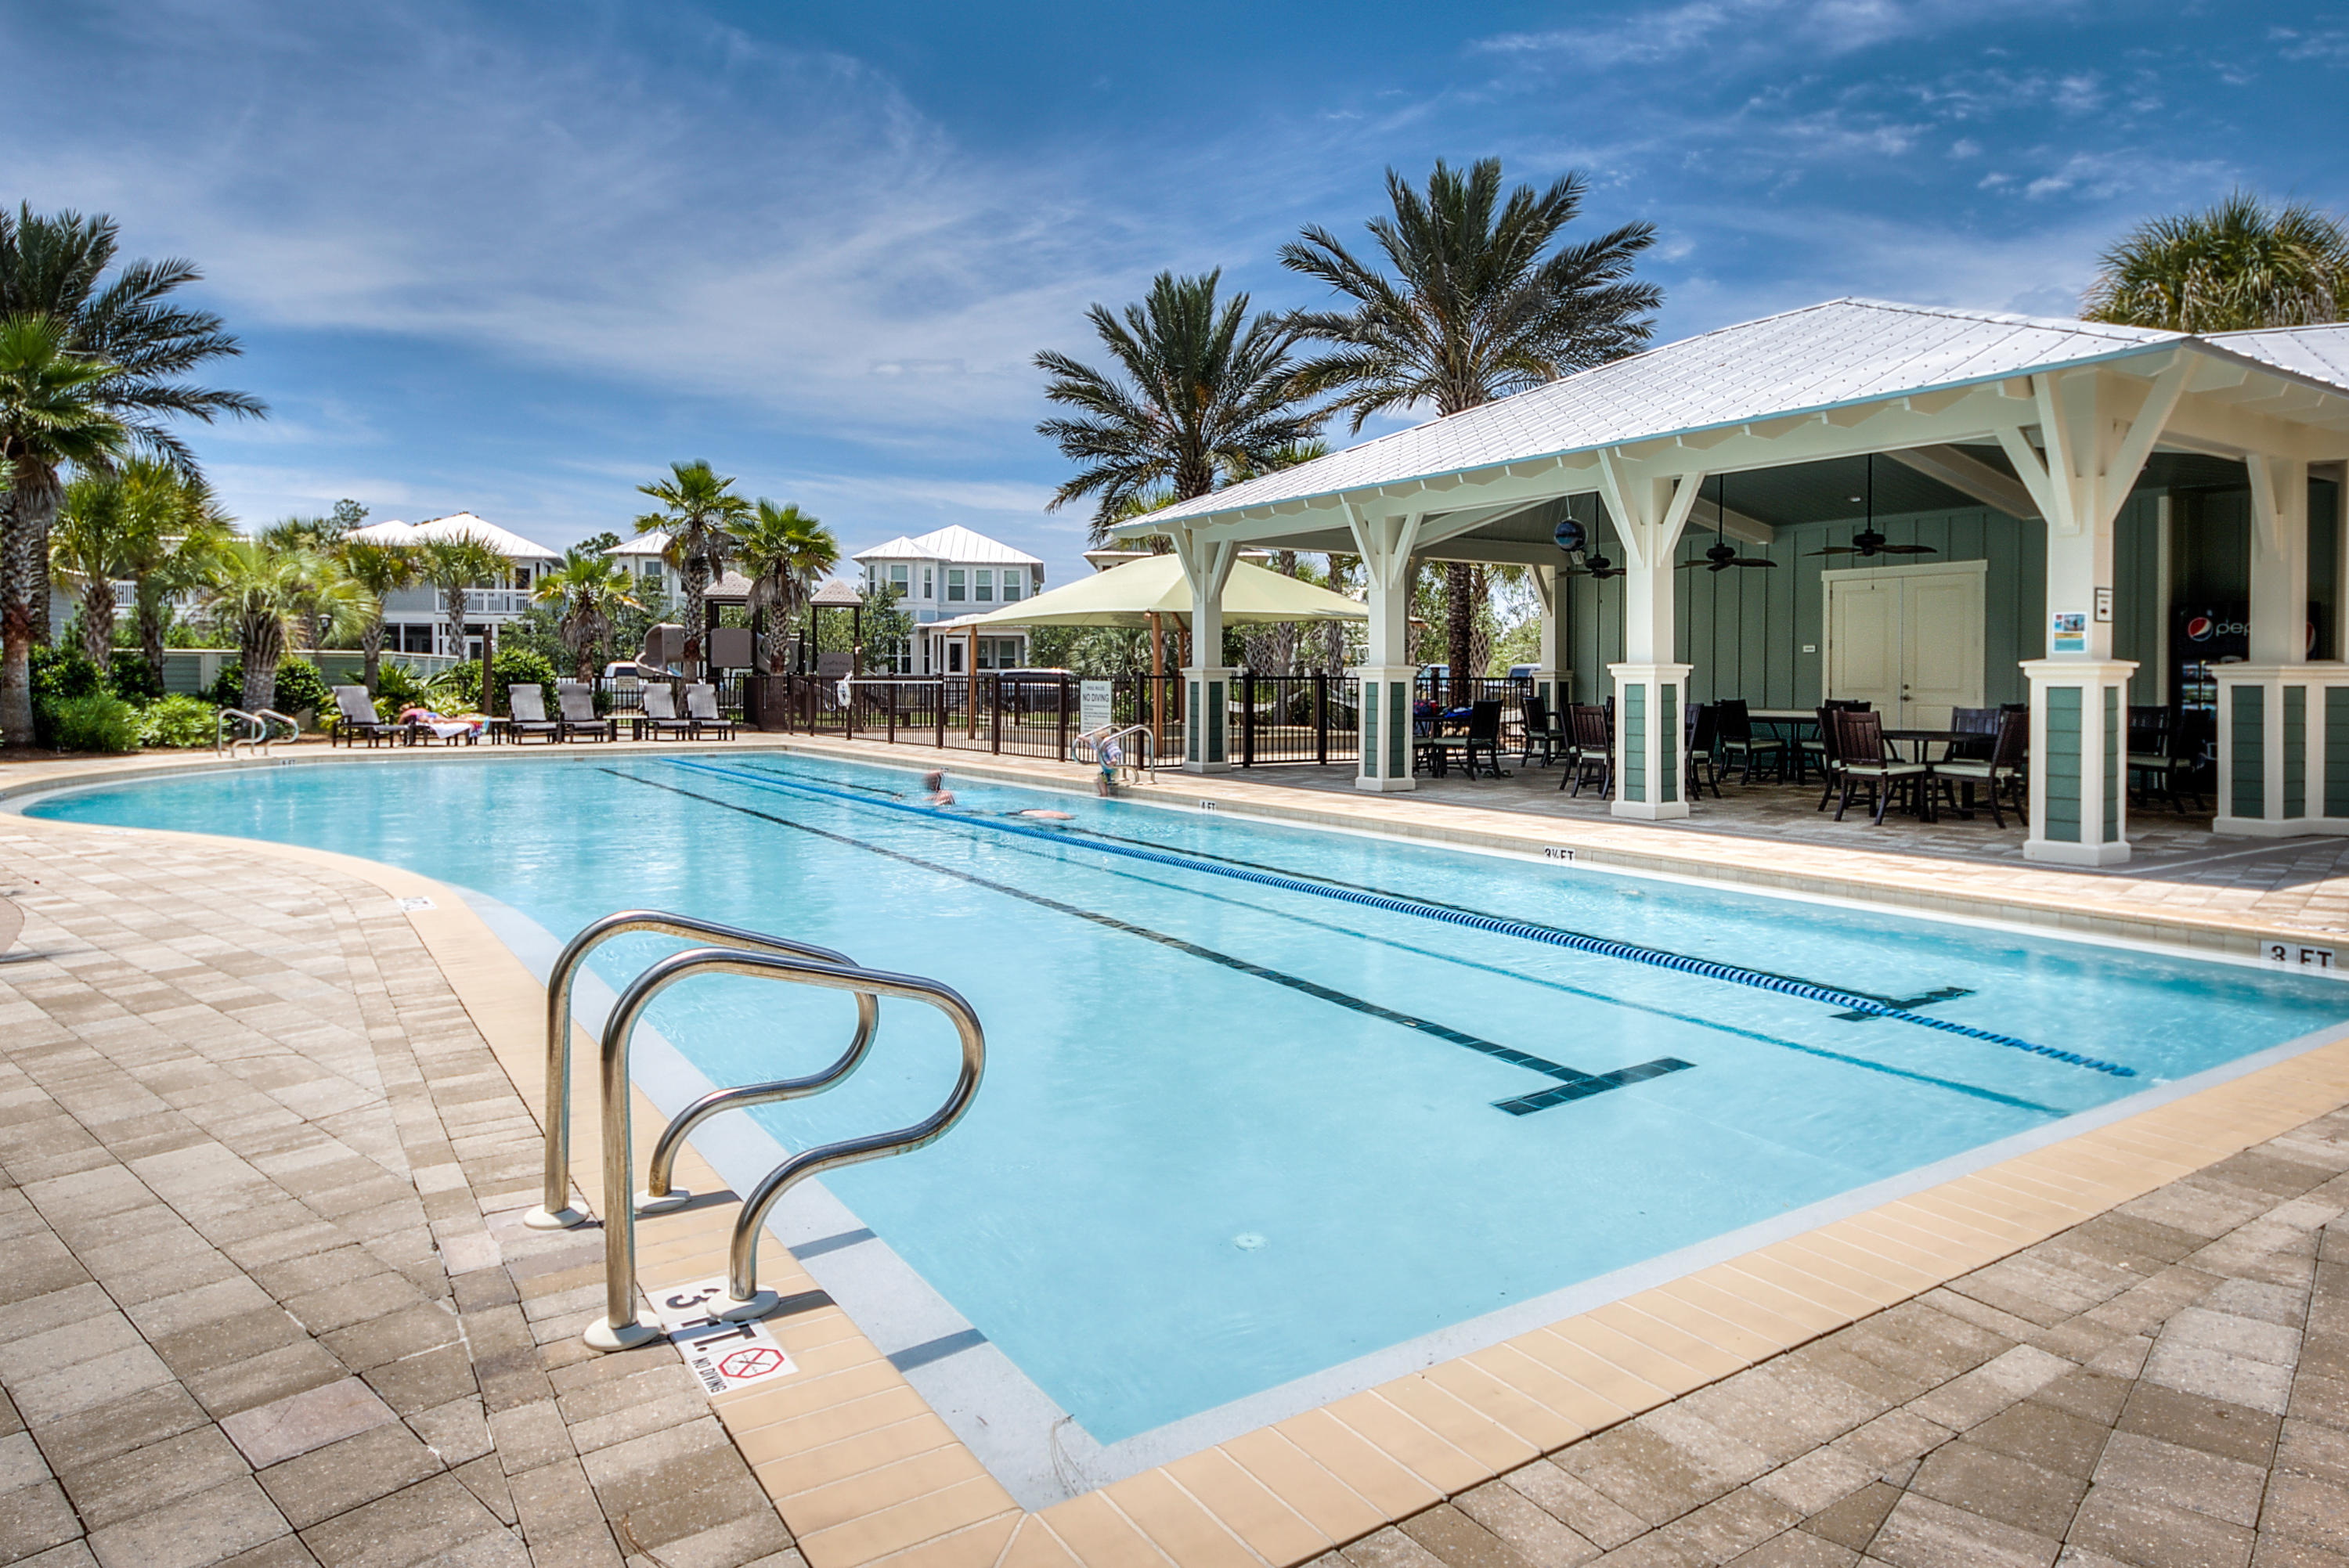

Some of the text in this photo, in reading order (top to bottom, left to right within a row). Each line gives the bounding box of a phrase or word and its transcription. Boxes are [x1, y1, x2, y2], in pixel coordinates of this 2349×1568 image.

[1092, 694, 1109, 702] DIVING
[2271, 946, 2333, 967] 3 FT
[666, 1288, 720, 1309] 3
[691, 1357, 727, 1393] NO DIVING
